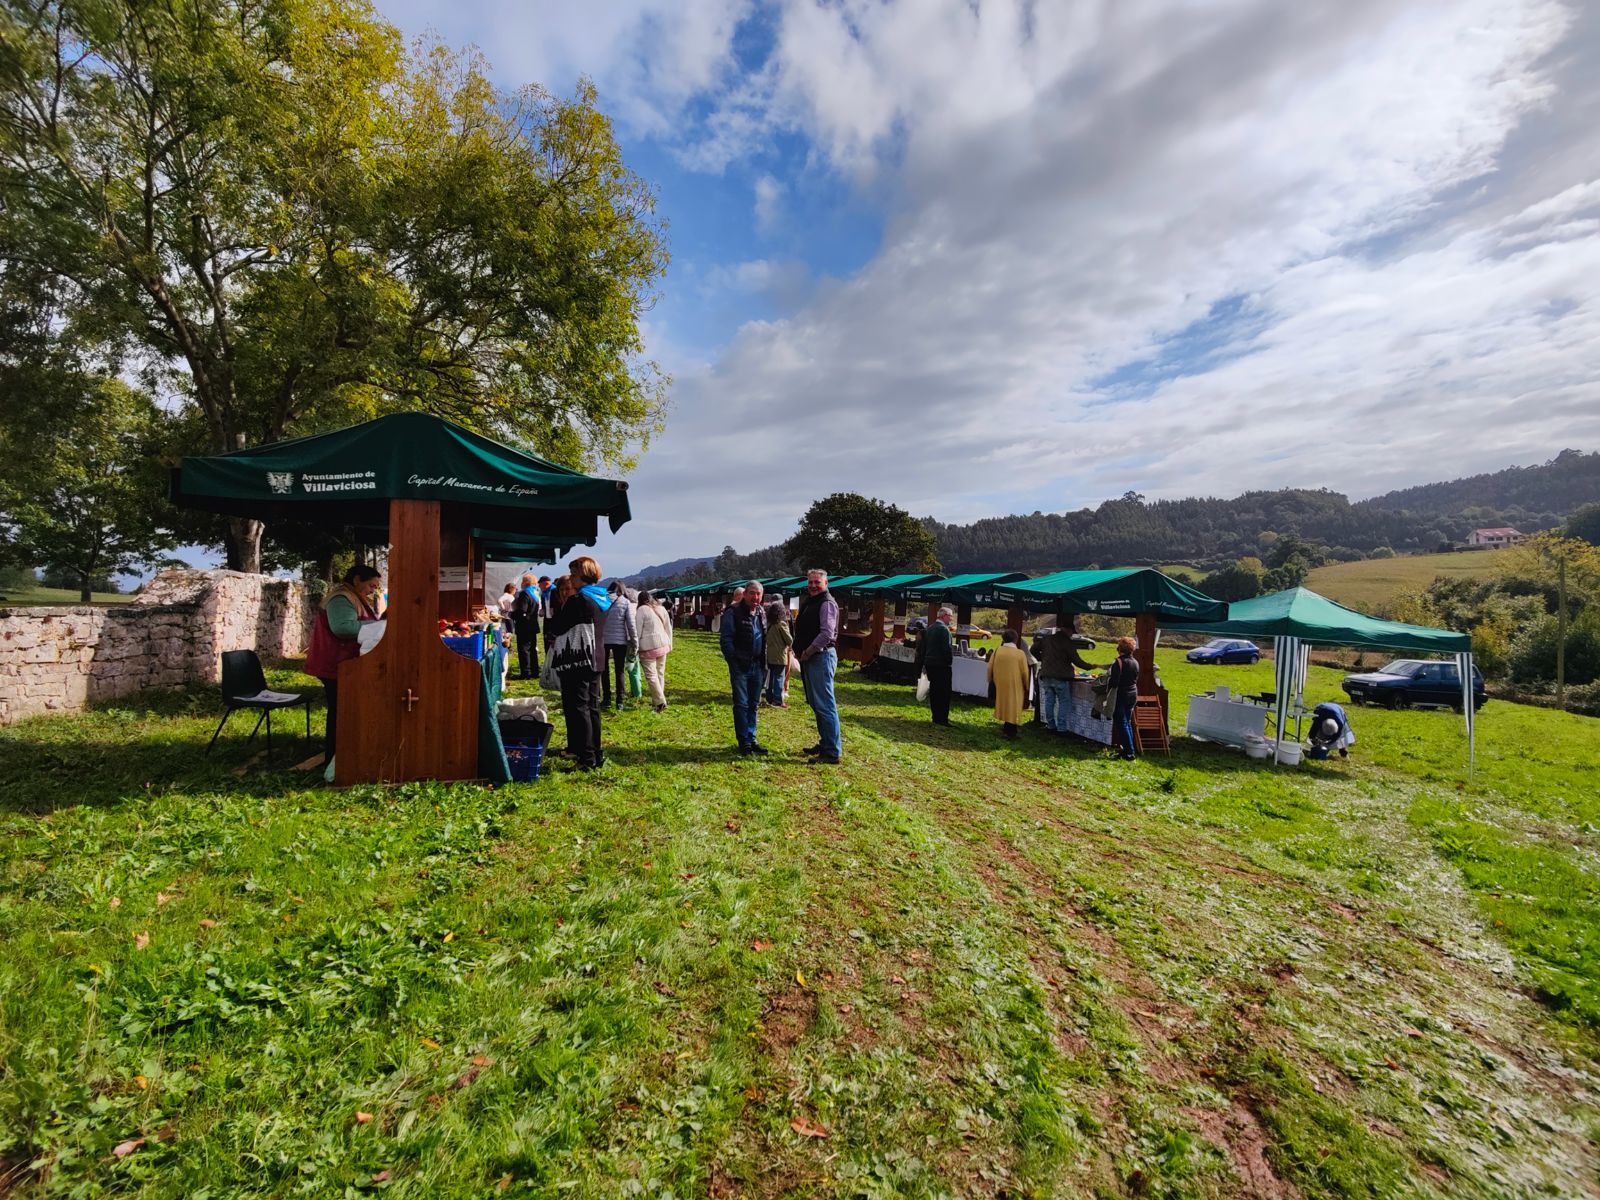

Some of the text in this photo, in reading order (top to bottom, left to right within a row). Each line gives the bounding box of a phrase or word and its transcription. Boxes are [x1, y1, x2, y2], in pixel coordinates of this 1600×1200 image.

[302, 472, 364, 481] Ayuntamiento
[303, 481, 376, 492] Villaviciosa
[407, 474, 538, 496] Capital Manzanera de España
